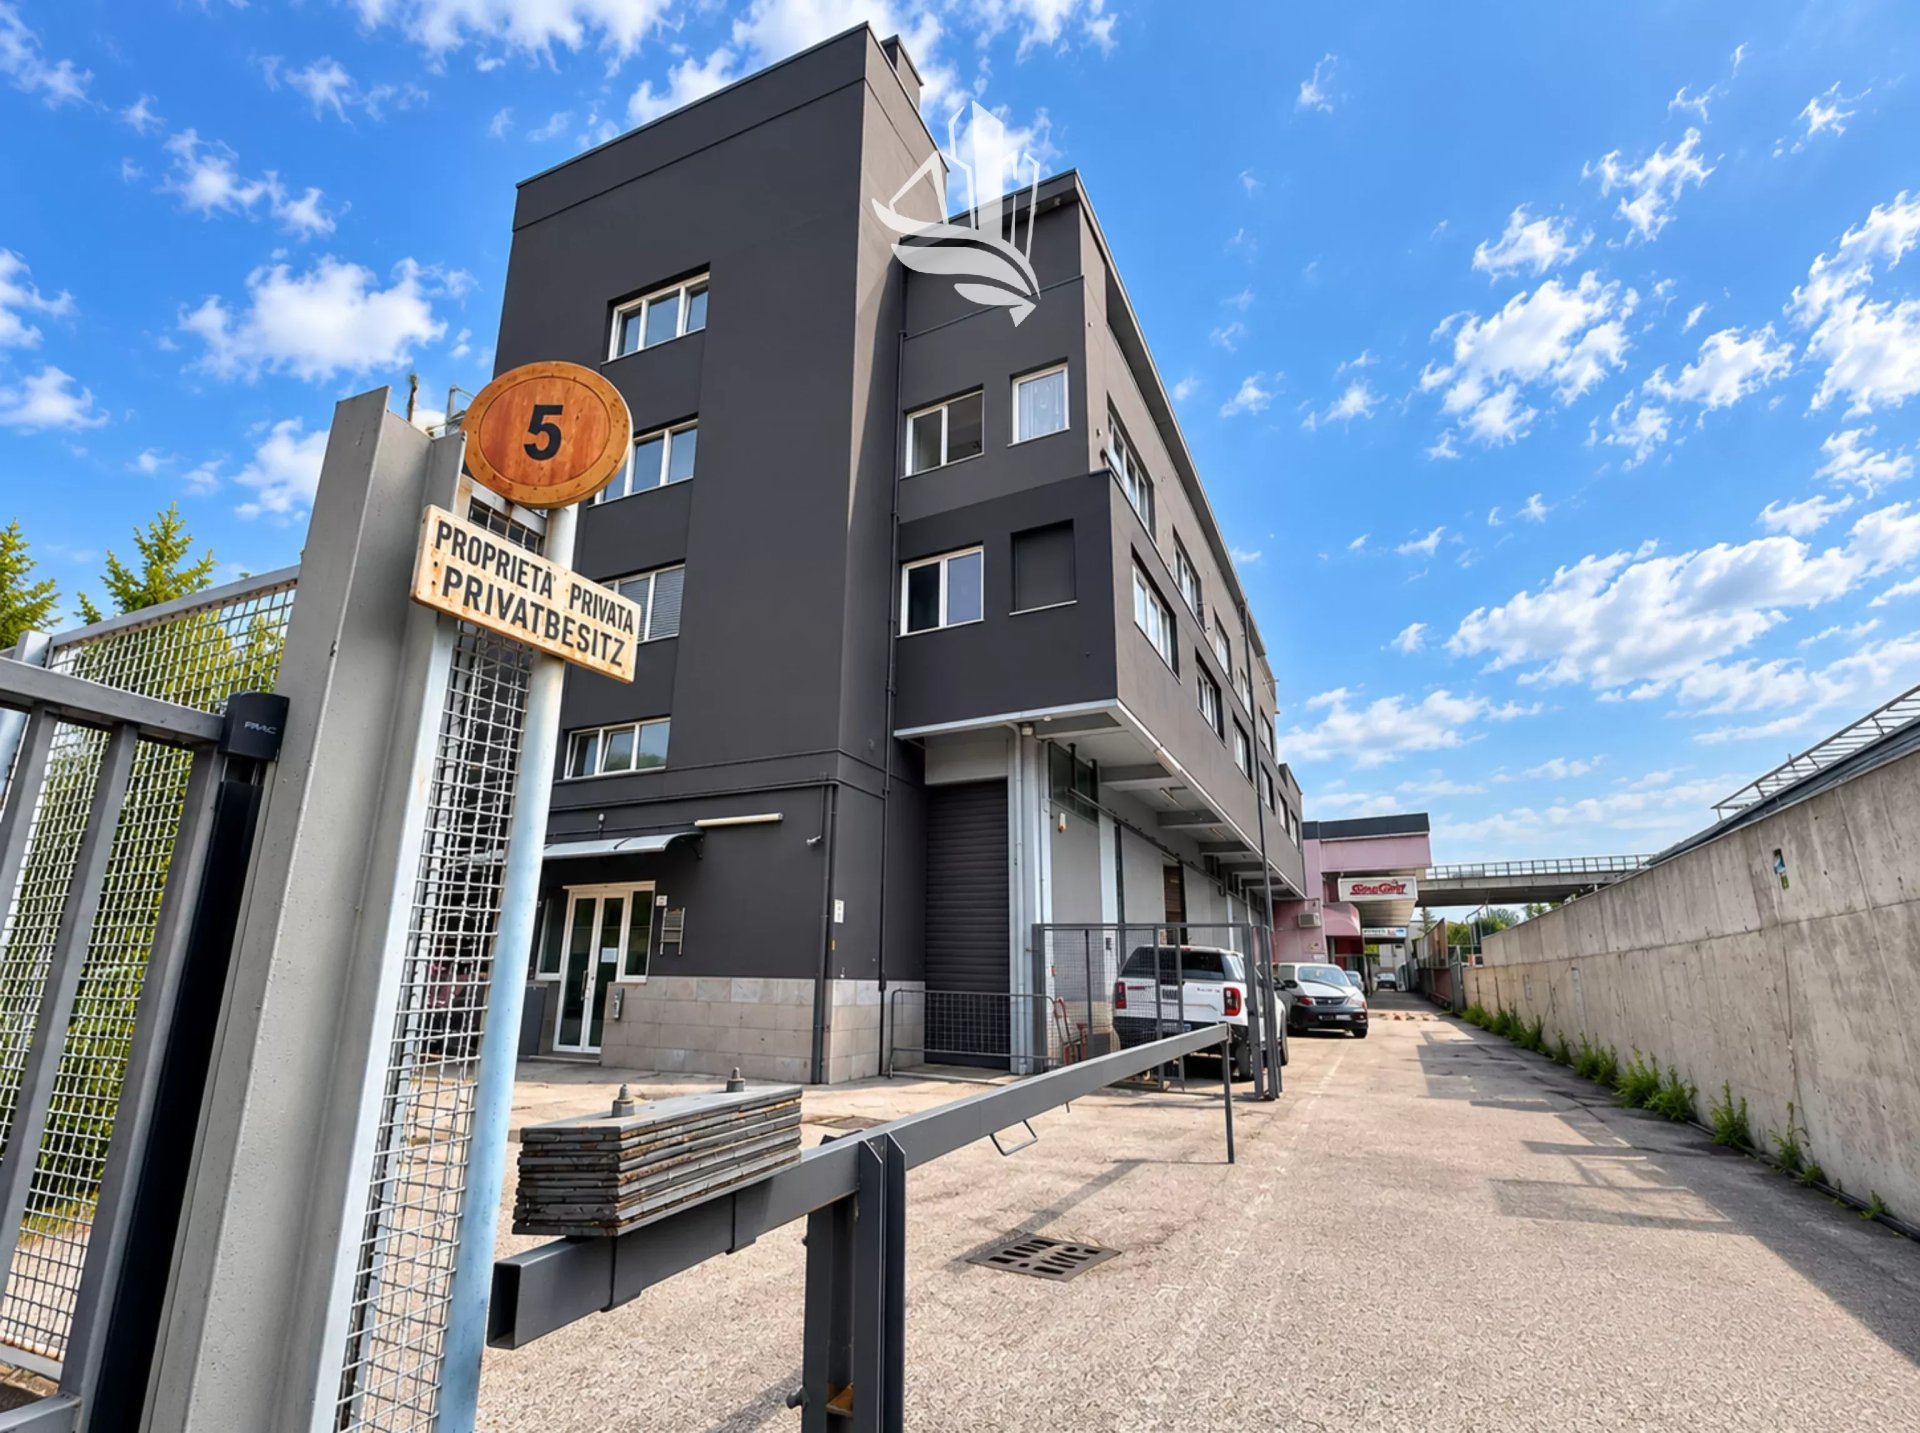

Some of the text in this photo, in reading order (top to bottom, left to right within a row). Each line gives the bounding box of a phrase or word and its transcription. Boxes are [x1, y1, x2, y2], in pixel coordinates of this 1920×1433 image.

[524, 404, 563, 460] 5
[435, 520, 634, 635] PROPRIETÀ PRIVATA
[441, 565, 626, 667] PRIVATBESITZ
